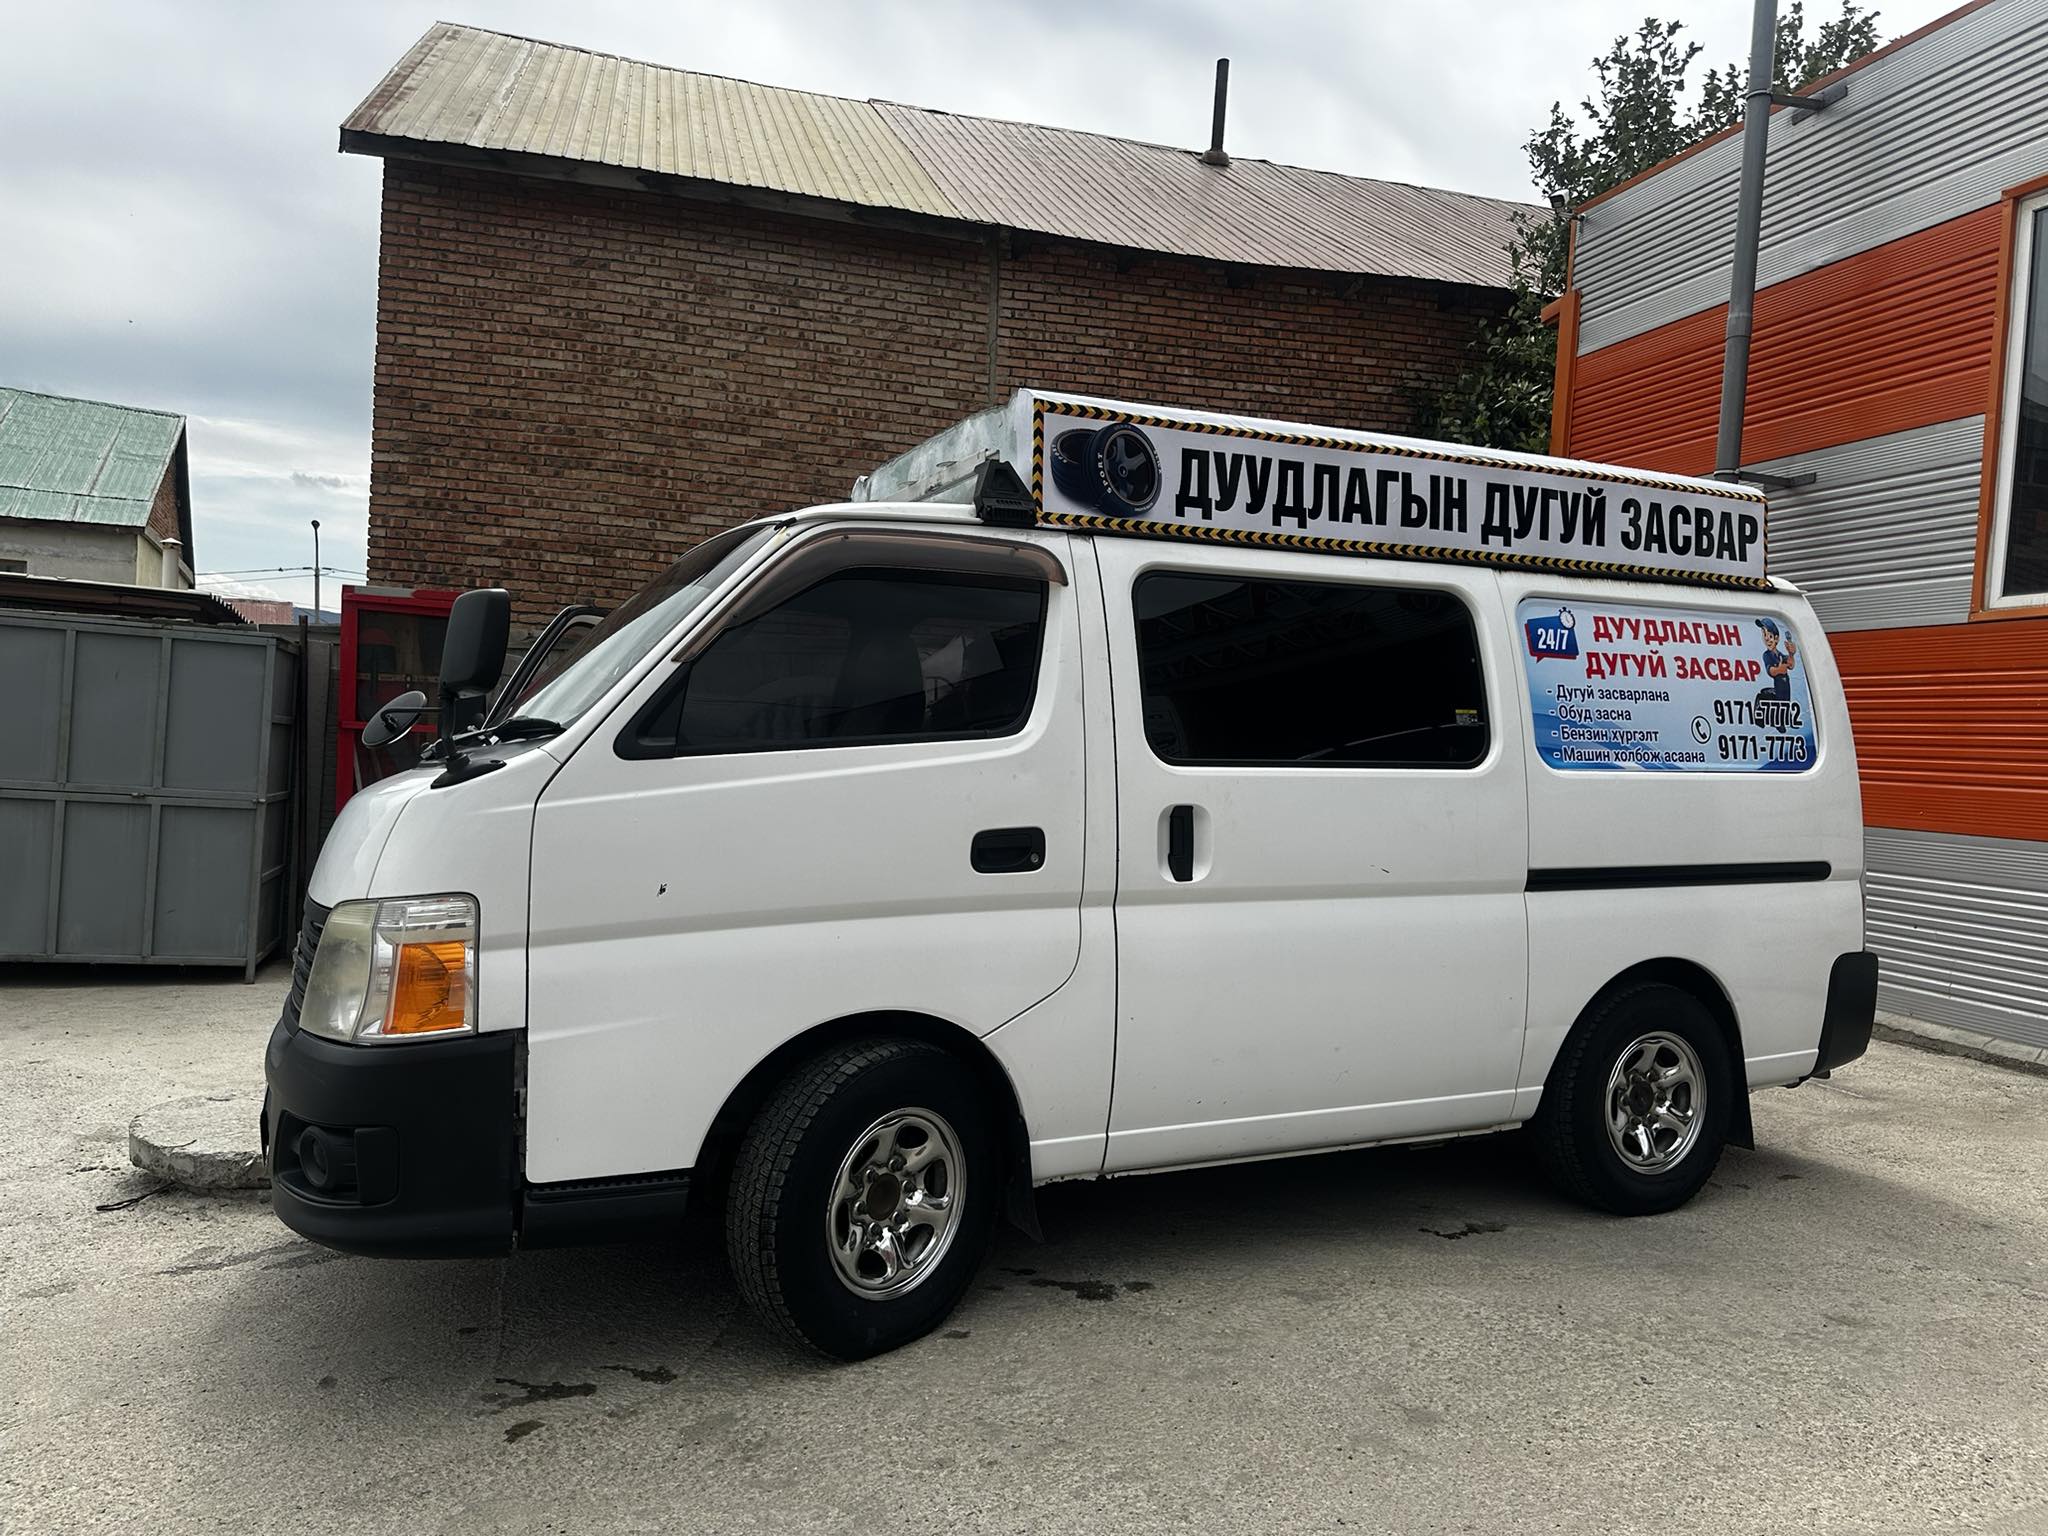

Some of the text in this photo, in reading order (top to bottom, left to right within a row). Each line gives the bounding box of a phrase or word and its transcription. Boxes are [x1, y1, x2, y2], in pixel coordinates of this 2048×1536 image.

[1175, 447, 1759, 562] ДУУДЛАГЫН ДУГУЙ ЗАСВАР
[1537, 627, 1569, 651] 24/7
[1592, 615, 1743, 647] ДУУДЛАГЫН
[1585, 650, 1762, 682] ДУГУЙ ЗАСВАР
[1556, 684, 1670, 704] Дугуй засварлана
[1558, 704, 1632, 722] Обуд засна
[1713, 699, 1803, 728] 9171-7772
[1561, 725, 1660, 745] Бензин хүргэлт
[1718, 734, 1807, 761] 9171-7773
[1563, 746, 1706, 763] Машин холбож асаана
